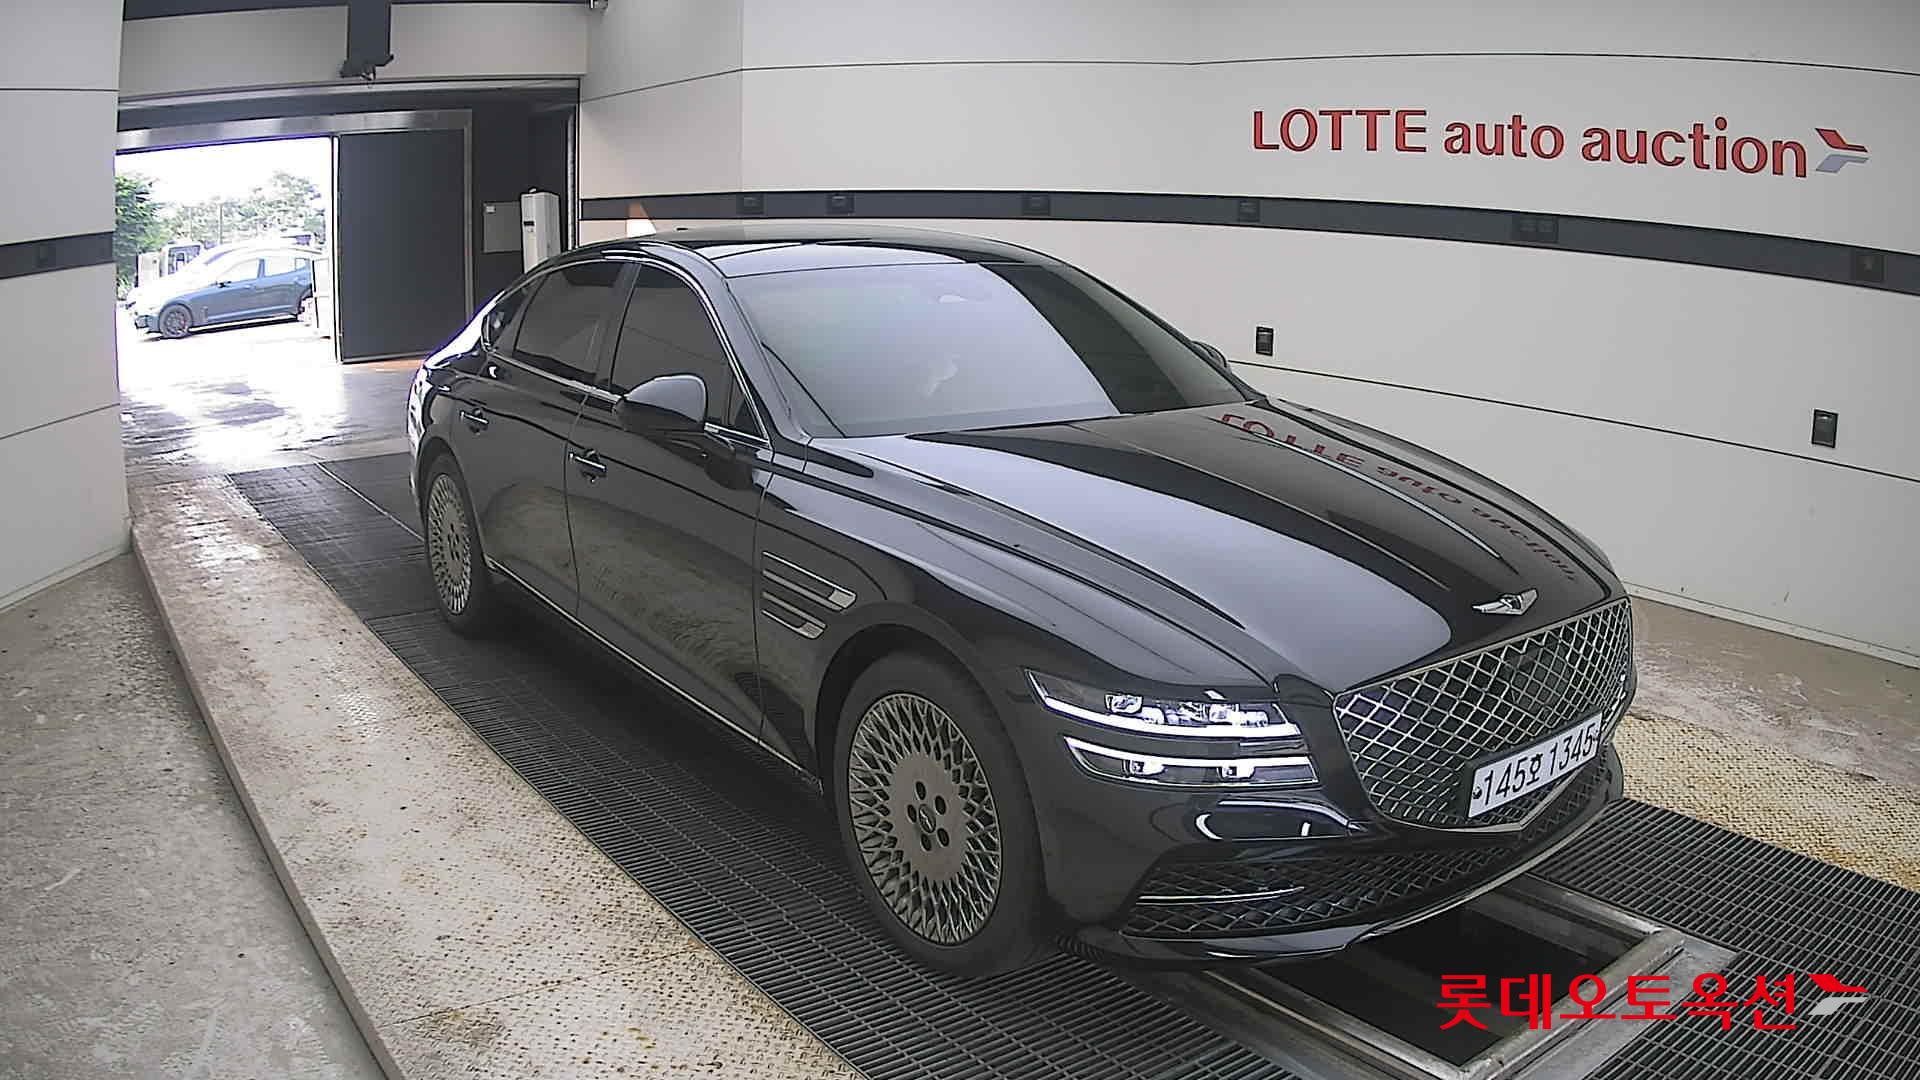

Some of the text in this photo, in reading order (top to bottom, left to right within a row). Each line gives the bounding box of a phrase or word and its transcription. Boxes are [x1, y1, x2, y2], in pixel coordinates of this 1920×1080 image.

[1253, 110, 1807, 178] LOTTE auto auction
[1484, 723, 1596, 805] 145호 1345
